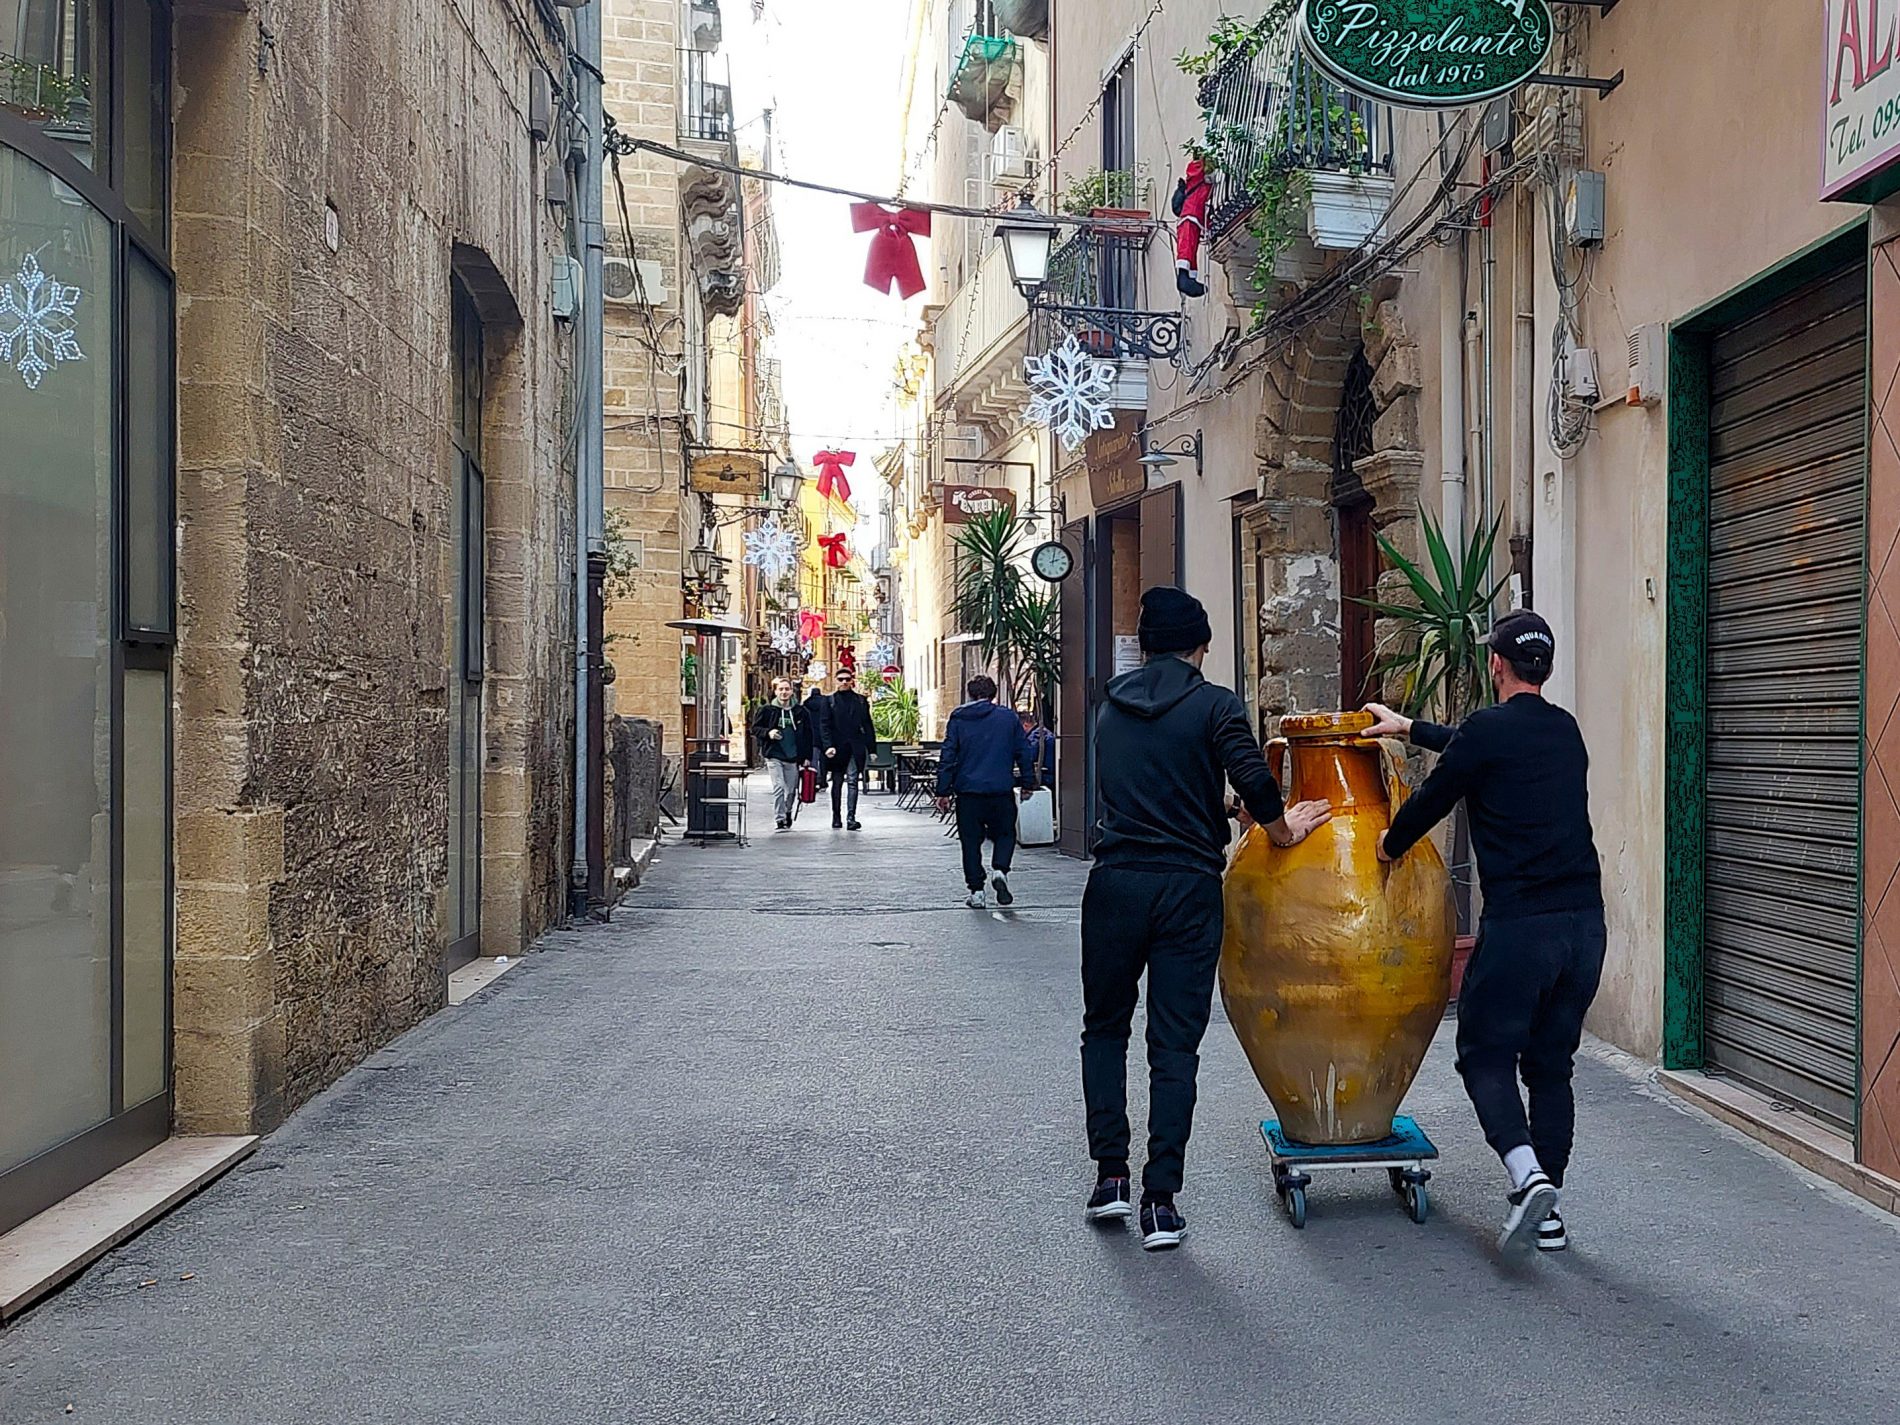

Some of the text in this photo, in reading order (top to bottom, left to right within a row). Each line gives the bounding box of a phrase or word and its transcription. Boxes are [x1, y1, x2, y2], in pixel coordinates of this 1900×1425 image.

[1334, 3, 1525, 67] Pizzolante
[1829, 0, 1900, 108] AL
[1388, 63, 1486, 88] dal 1975
[1830, 113, 1867, 166] Tel.
[791, 655, 799, 677] BAR
